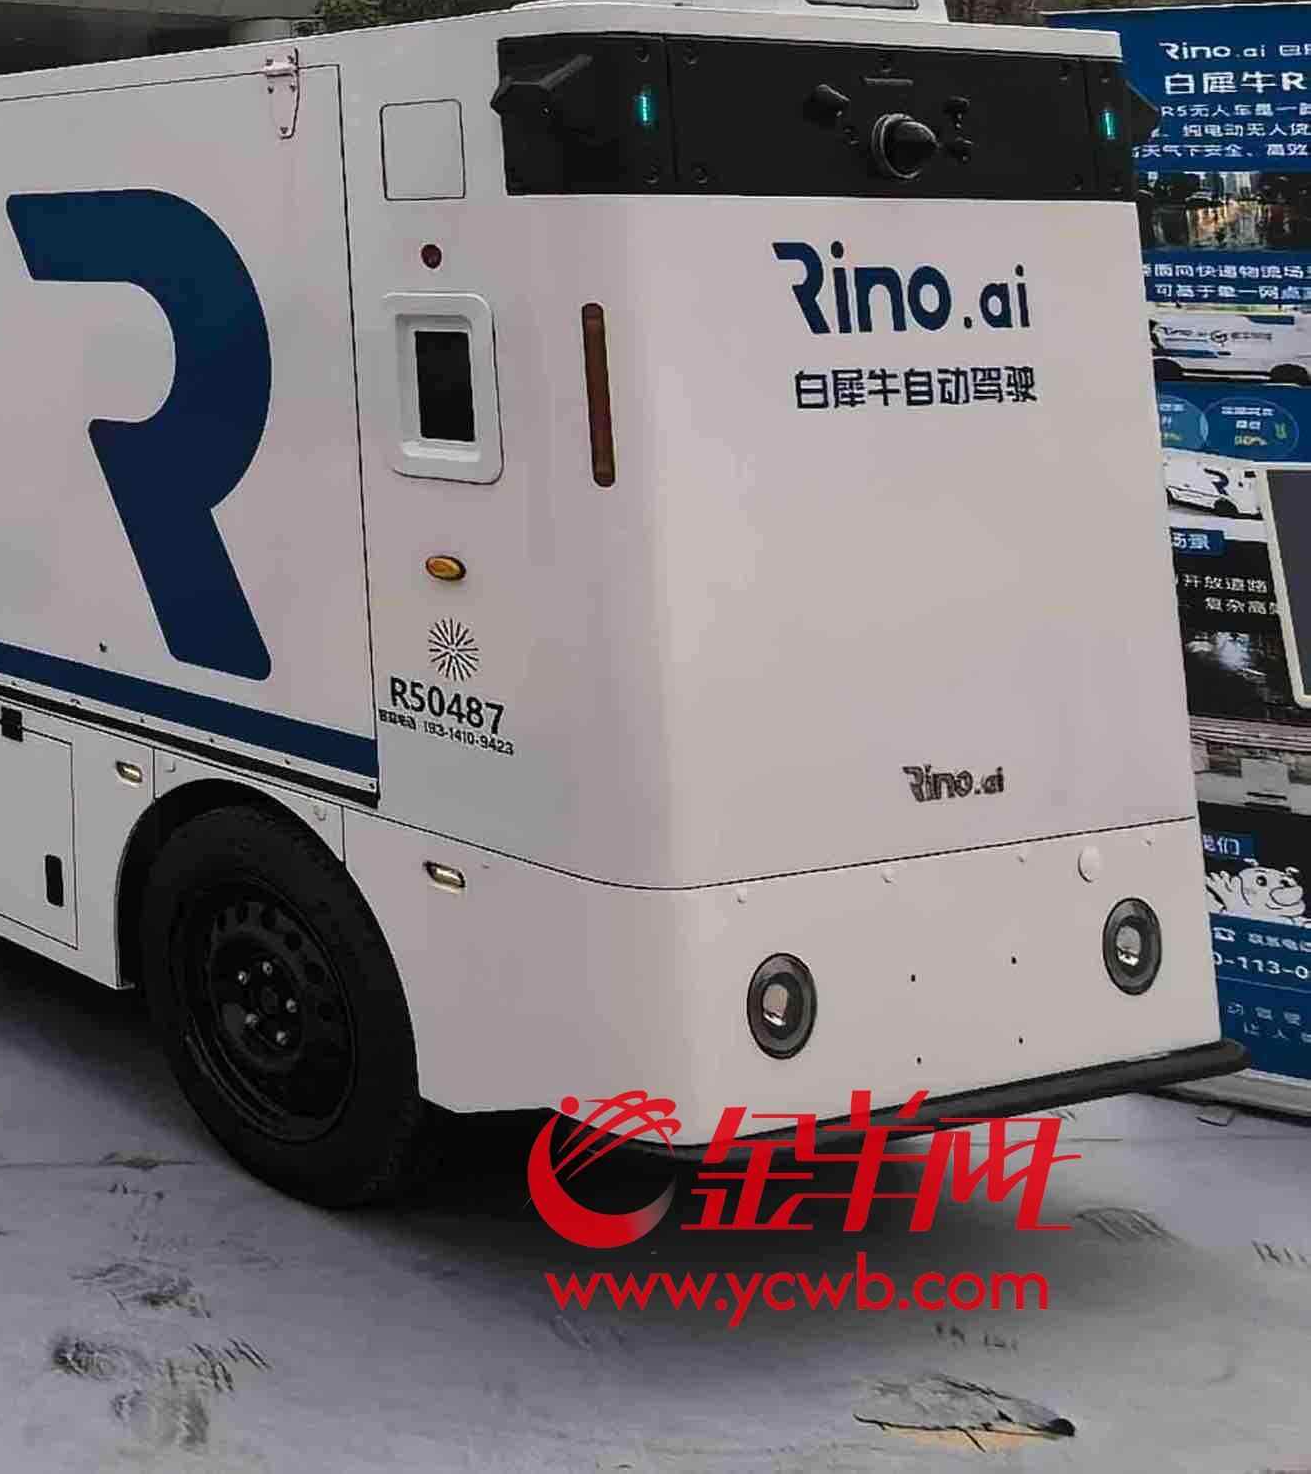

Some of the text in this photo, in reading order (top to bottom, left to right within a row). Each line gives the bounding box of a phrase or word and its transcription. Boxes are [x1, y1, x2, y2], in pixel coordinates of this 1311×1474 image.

[1159, 42, 1266, 60] Rino.ai
[1164, 71, 1308, 95] 白犀牛R
[771, 240, 1031, 334] Rino.ai
[794, 366, 1037, 409] 白犀牛自动驾驶
[5, 188, 273, 682] R
[389, 676, 504, 735] R50487
[902, 765, 1005, 802] Rino.ai
